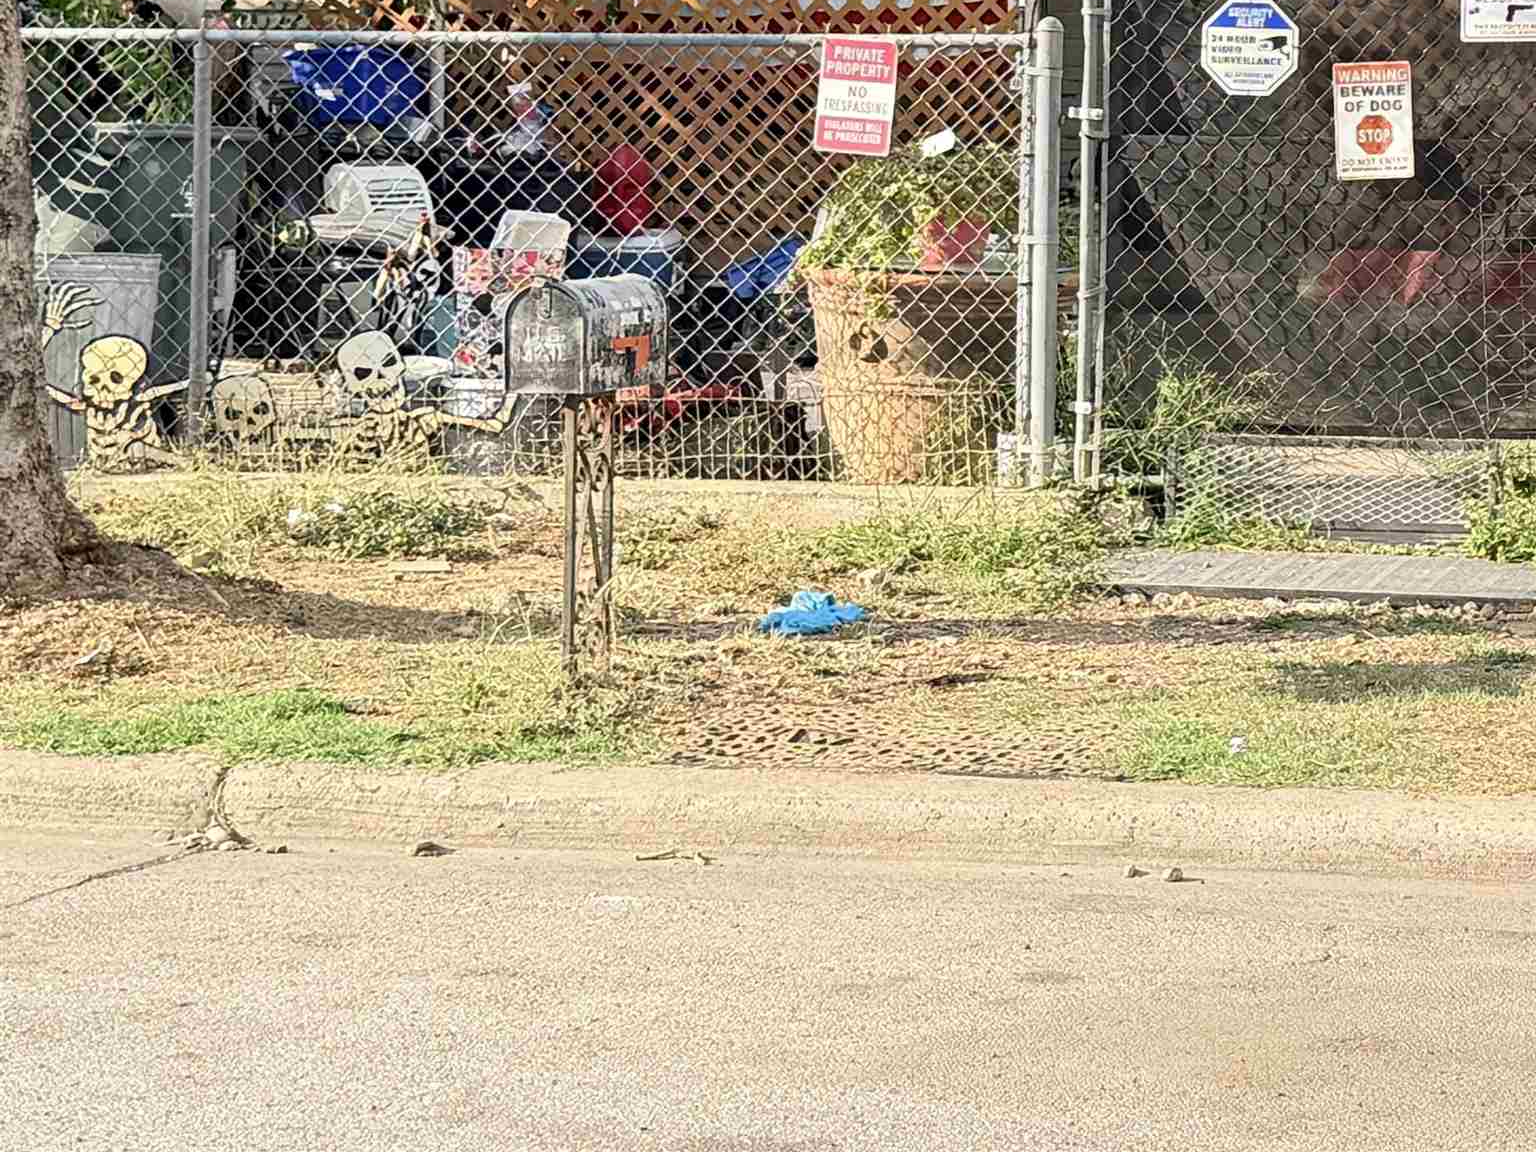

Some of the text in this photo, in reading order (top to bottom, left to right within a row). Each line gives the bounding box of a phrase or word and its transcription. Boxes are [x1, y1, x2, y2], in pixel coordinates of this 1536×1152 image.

[1228, 7, 1273, 18] SECURITY
[1235, 16, 1266, 27] ALERT
[1226, 35, 1256, 43] HOUR
[833, 45, 887, 63] PRIVATE
[1211, 56, 1282, 65] SURVEILLANCE
[826, 60, 891, 78] PROPERTY
[1337, 68, 1408, 82] WARNING
[848, 86, 868, 98] NO
[1340, 84, 1407, 97] BEWARE
[823, 98, 889, 114] TRESPASSING
[1344, 100, 1403, 112] OF DOG
[1359, 128, 1392, 144] STOP
